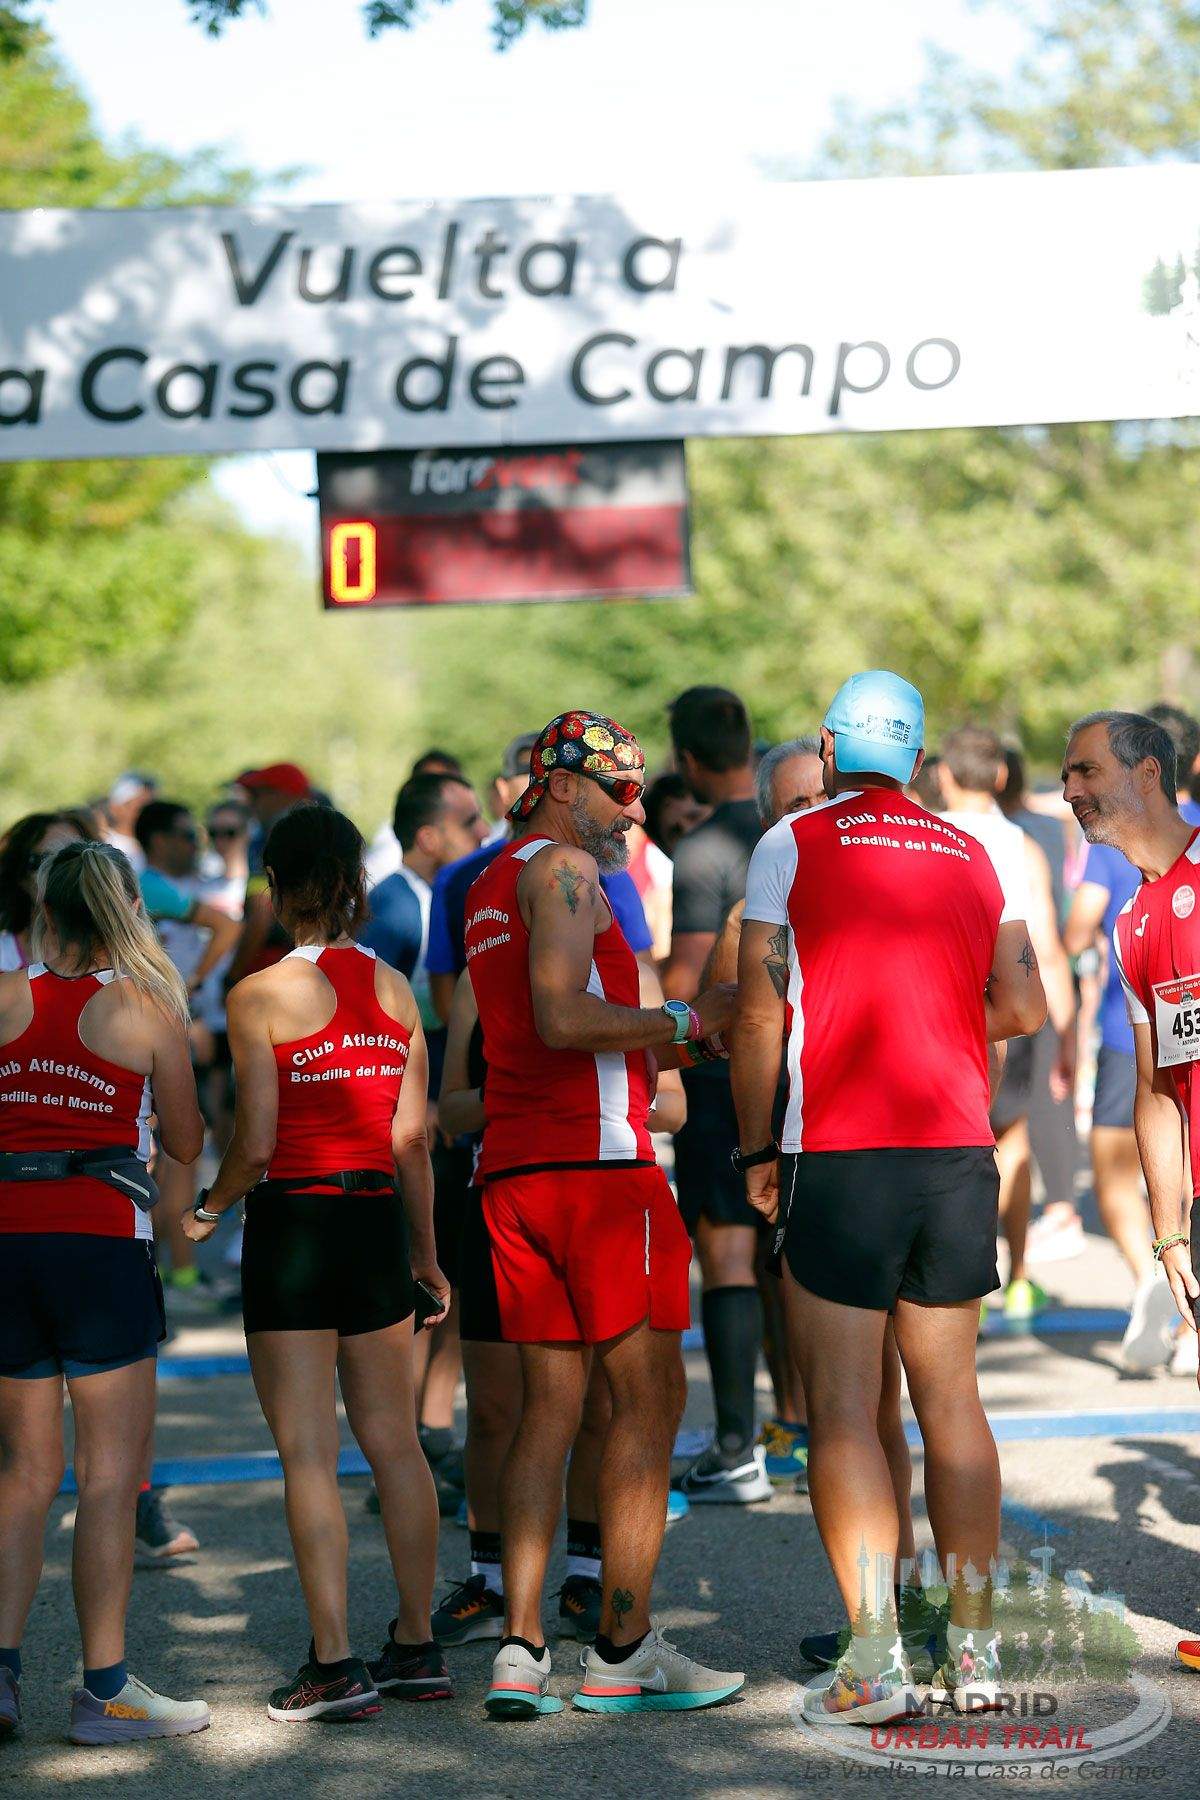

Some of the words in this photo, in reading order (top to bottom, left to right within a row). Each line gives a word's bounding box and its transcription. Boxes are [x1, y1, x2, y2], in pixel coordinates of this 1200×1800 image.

[221, 221, 577, 306] Vuelta
[622, 236, 682, 294] a
[80, 346, 349, 422] Casa
[395, 335, 526, 412] de
[570, 331, 962, 416] Campo
[329, 520, 377, 603] 0
[836, 812, 877, 830] Club
[882, 813, 967, 849] Atletismo
[840, 835, 900, 849] Boadilla
[904, 839, 927, 852] del
[930, 841, 971, 862] Monte
[1172, 1008, 1200, 1040] 453
[292, 1040, 335, 1066] Club
[28, 1058, 116, 1096] Atletismo
[290, 1067, 351, 1083] Boadilla
[355, 1065, 376, 1077] del
[42, 1093, 64, 1106] del
[68, 1096, 114, 1113] Monte
